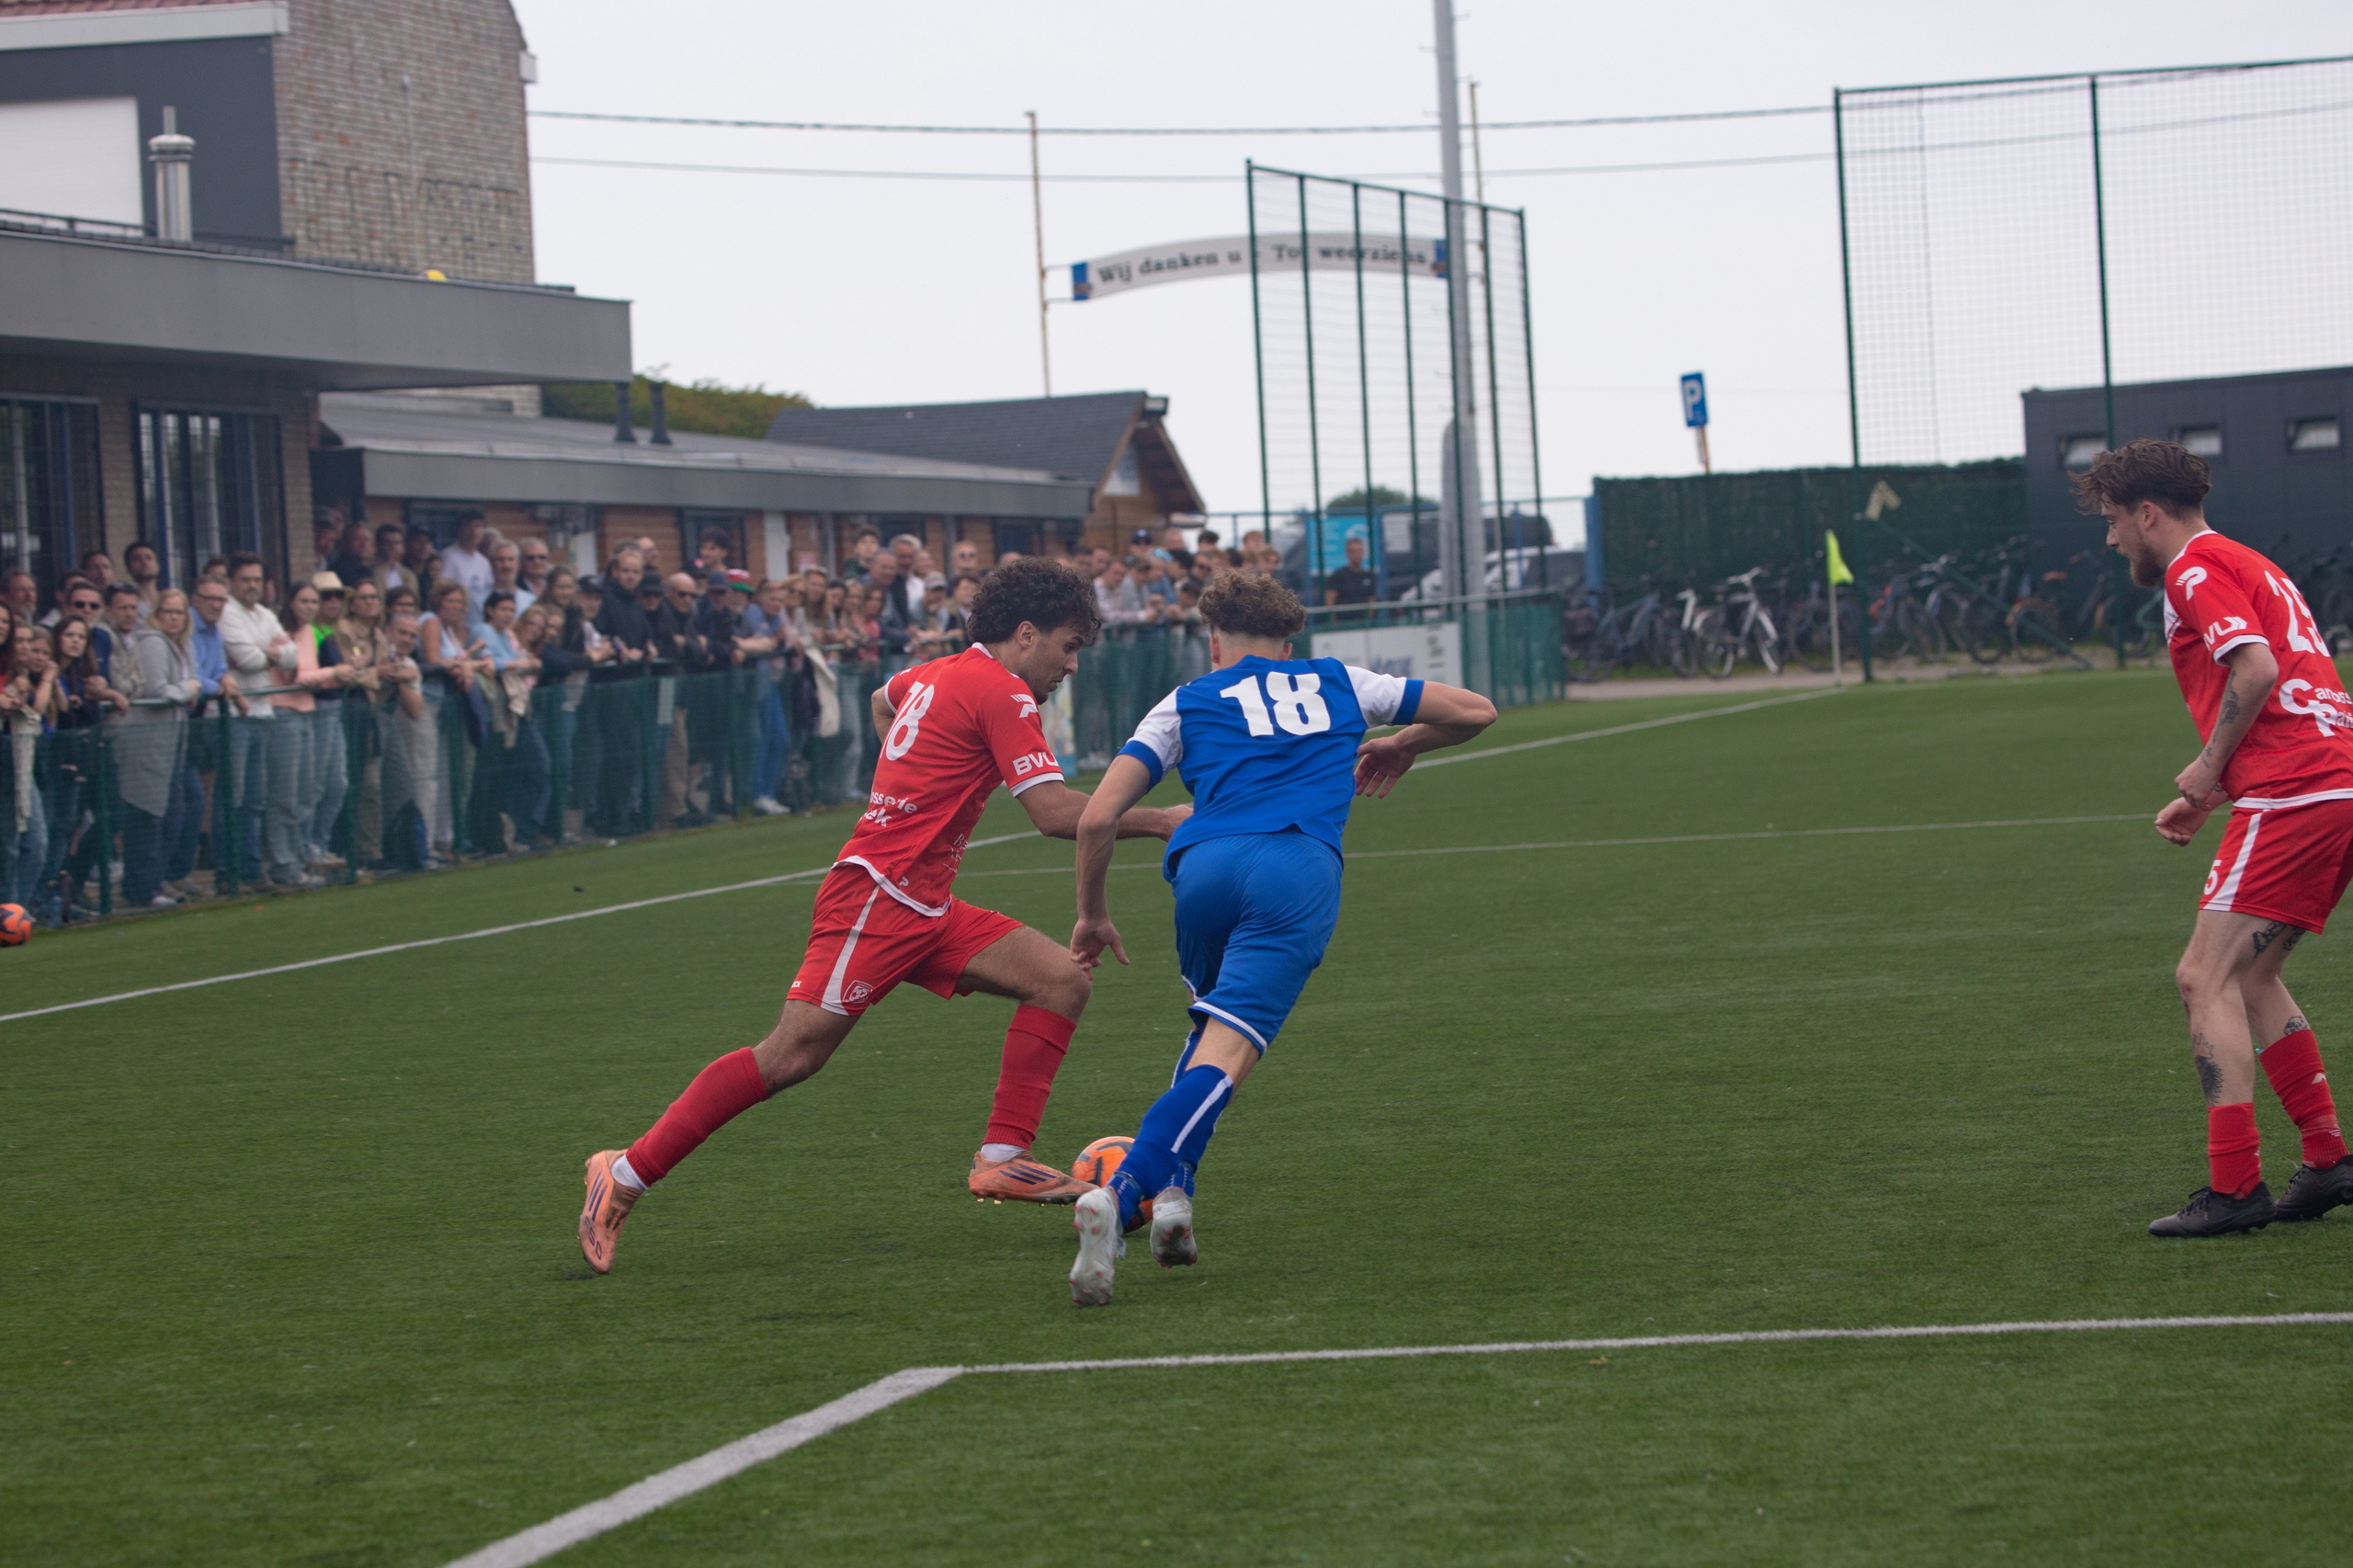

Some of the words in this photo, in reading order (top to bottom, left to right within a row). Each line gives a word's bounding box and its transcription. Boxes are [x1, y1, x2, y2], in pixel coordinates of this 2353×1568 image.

[1098, 261, 1131, 283] Wij
[1140, 251, 1219, 275] danken
[1228, 250, 1241, 264] u
[1273, 244, 1306, 261] To
[1682, 379, 1703, 420] P
[2203, 616, 2247, 651] VU
[2264, 571, 2330, 657] 25
[880, 681, 935, 761] 18
[1219, 671, 1331, 737] 18
